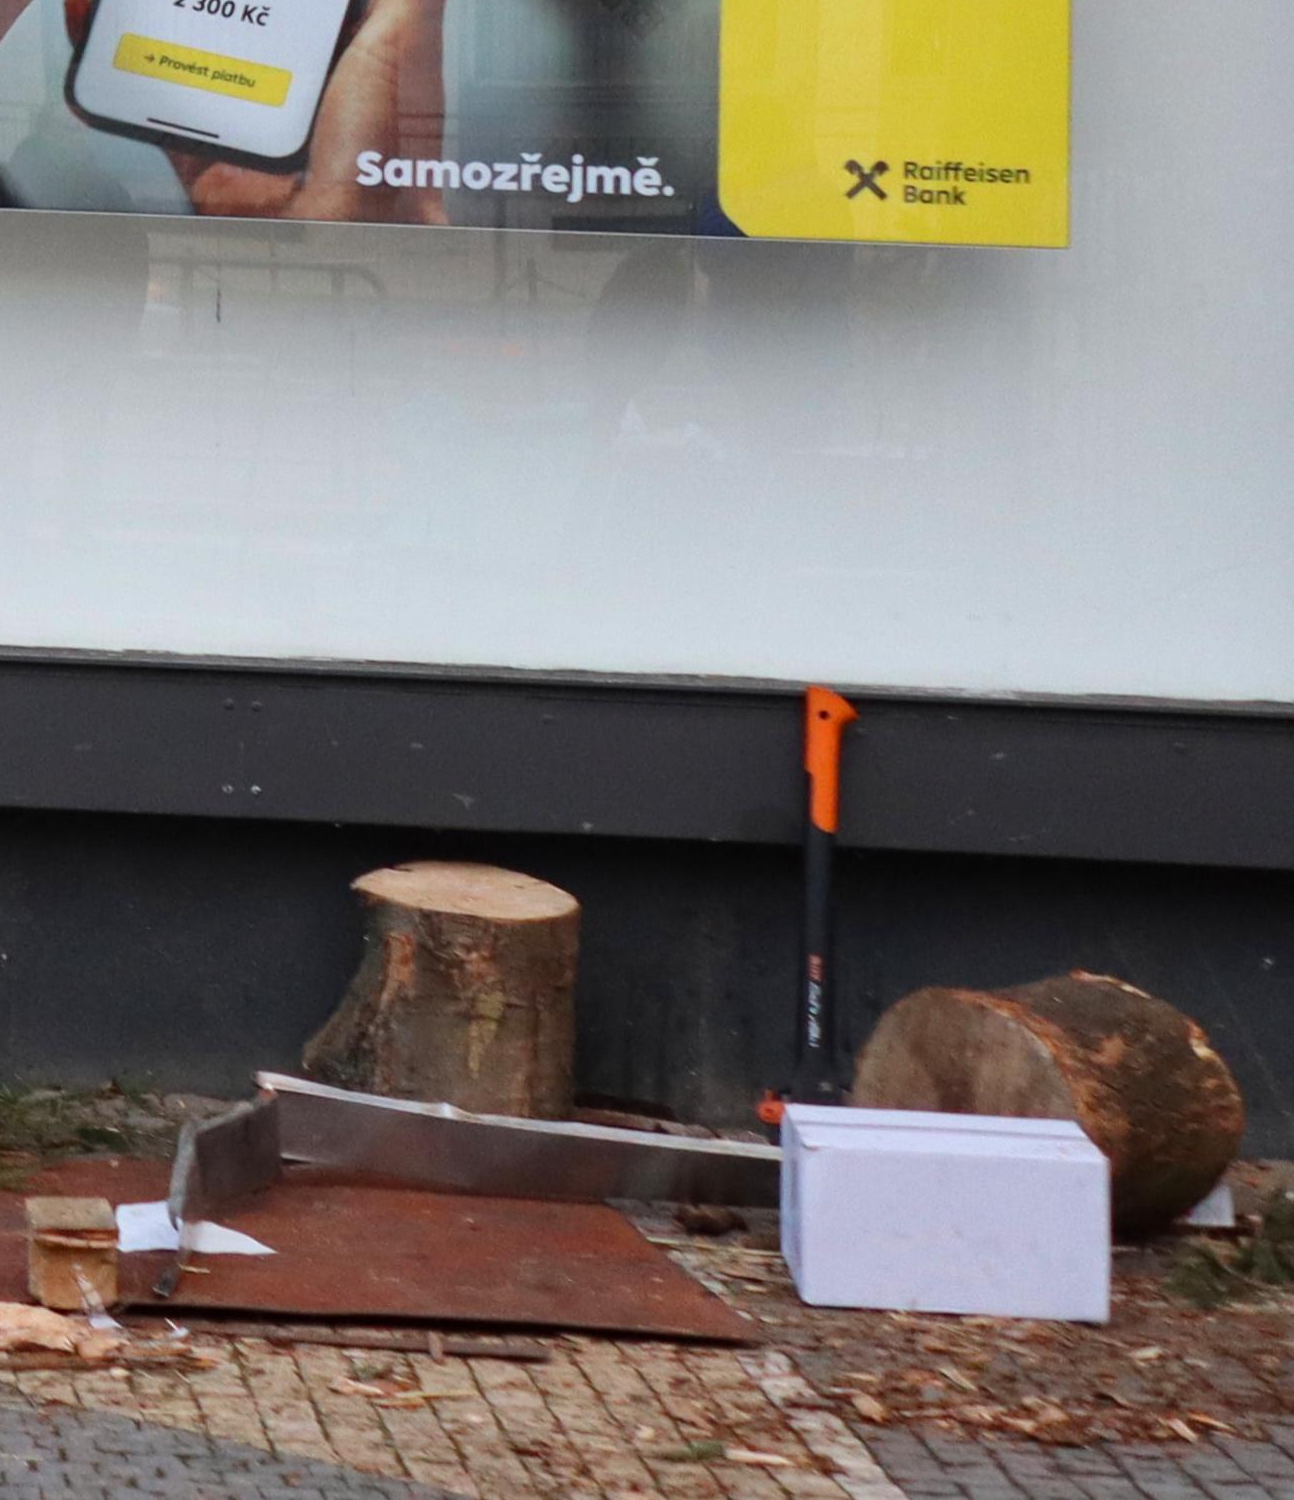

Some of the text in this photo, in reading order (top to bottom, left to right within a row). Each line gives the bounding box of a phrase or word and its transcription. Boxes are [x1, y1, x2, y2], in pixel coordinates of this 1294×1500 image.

[240, 3, 271, 27] Kč
[159, 55, 256, 88] Provést platbu
[355, 150, 676, 203] Samozřejmě.
[903, 160, 1031, 184] Raiffeisen
[903, 184, 967, 205] Bank
